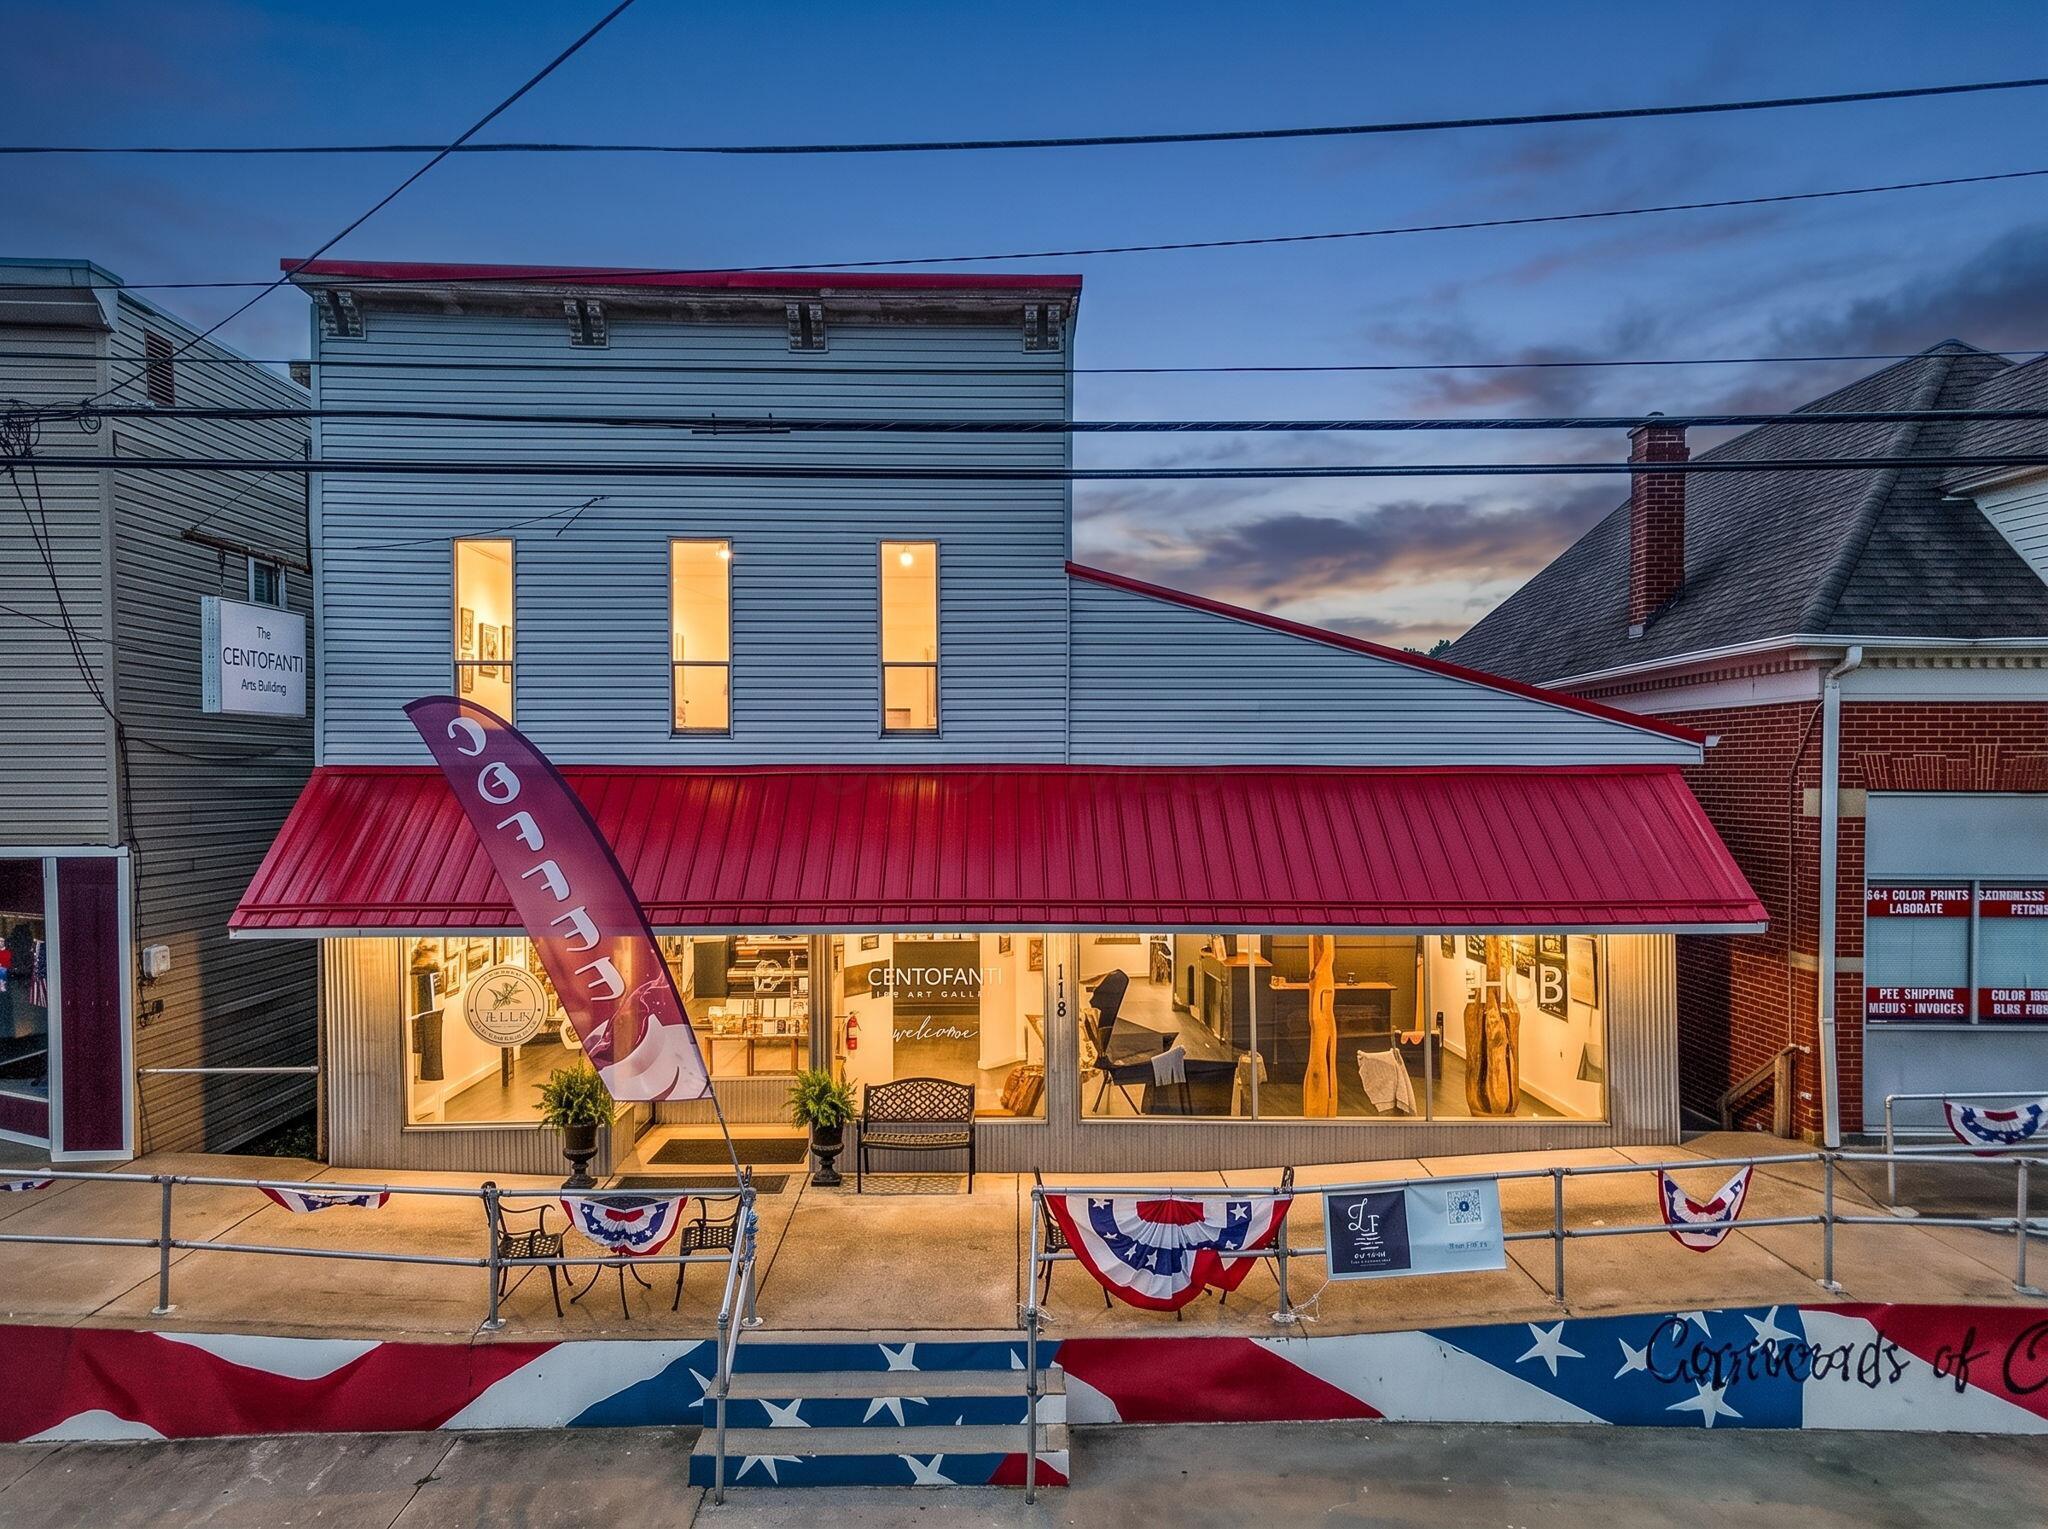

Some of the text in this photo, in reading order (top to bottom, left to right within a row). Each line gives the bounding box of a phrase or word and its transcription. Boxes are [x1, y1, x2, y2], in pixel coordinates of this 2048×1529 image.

[256, 626, 271, 640] The
[222, 647, 303, 673] CENTOFANTI
[241, 678, 287, 696] Arts Building
[1892, 890, 1925, 900] COLOR
[1930, 890, 1969, 900] PRINTS
[1889, 903, 1943, 914] LABORATE
[867, 967, 1002, 987] CENTOFANTI
[1480, 963, 1563, 1004] HUB
[907, 990, 932, 998] ART
[1057, 963, 1067, 1017] 118
[1904, 989, 1954, 1000] SHIPPING
[1991, 990, 2026, 1001] COLOR
[1914, 1003, 1965, 1014] INVOICES
[1933, 1326, 1991, 1394] of
